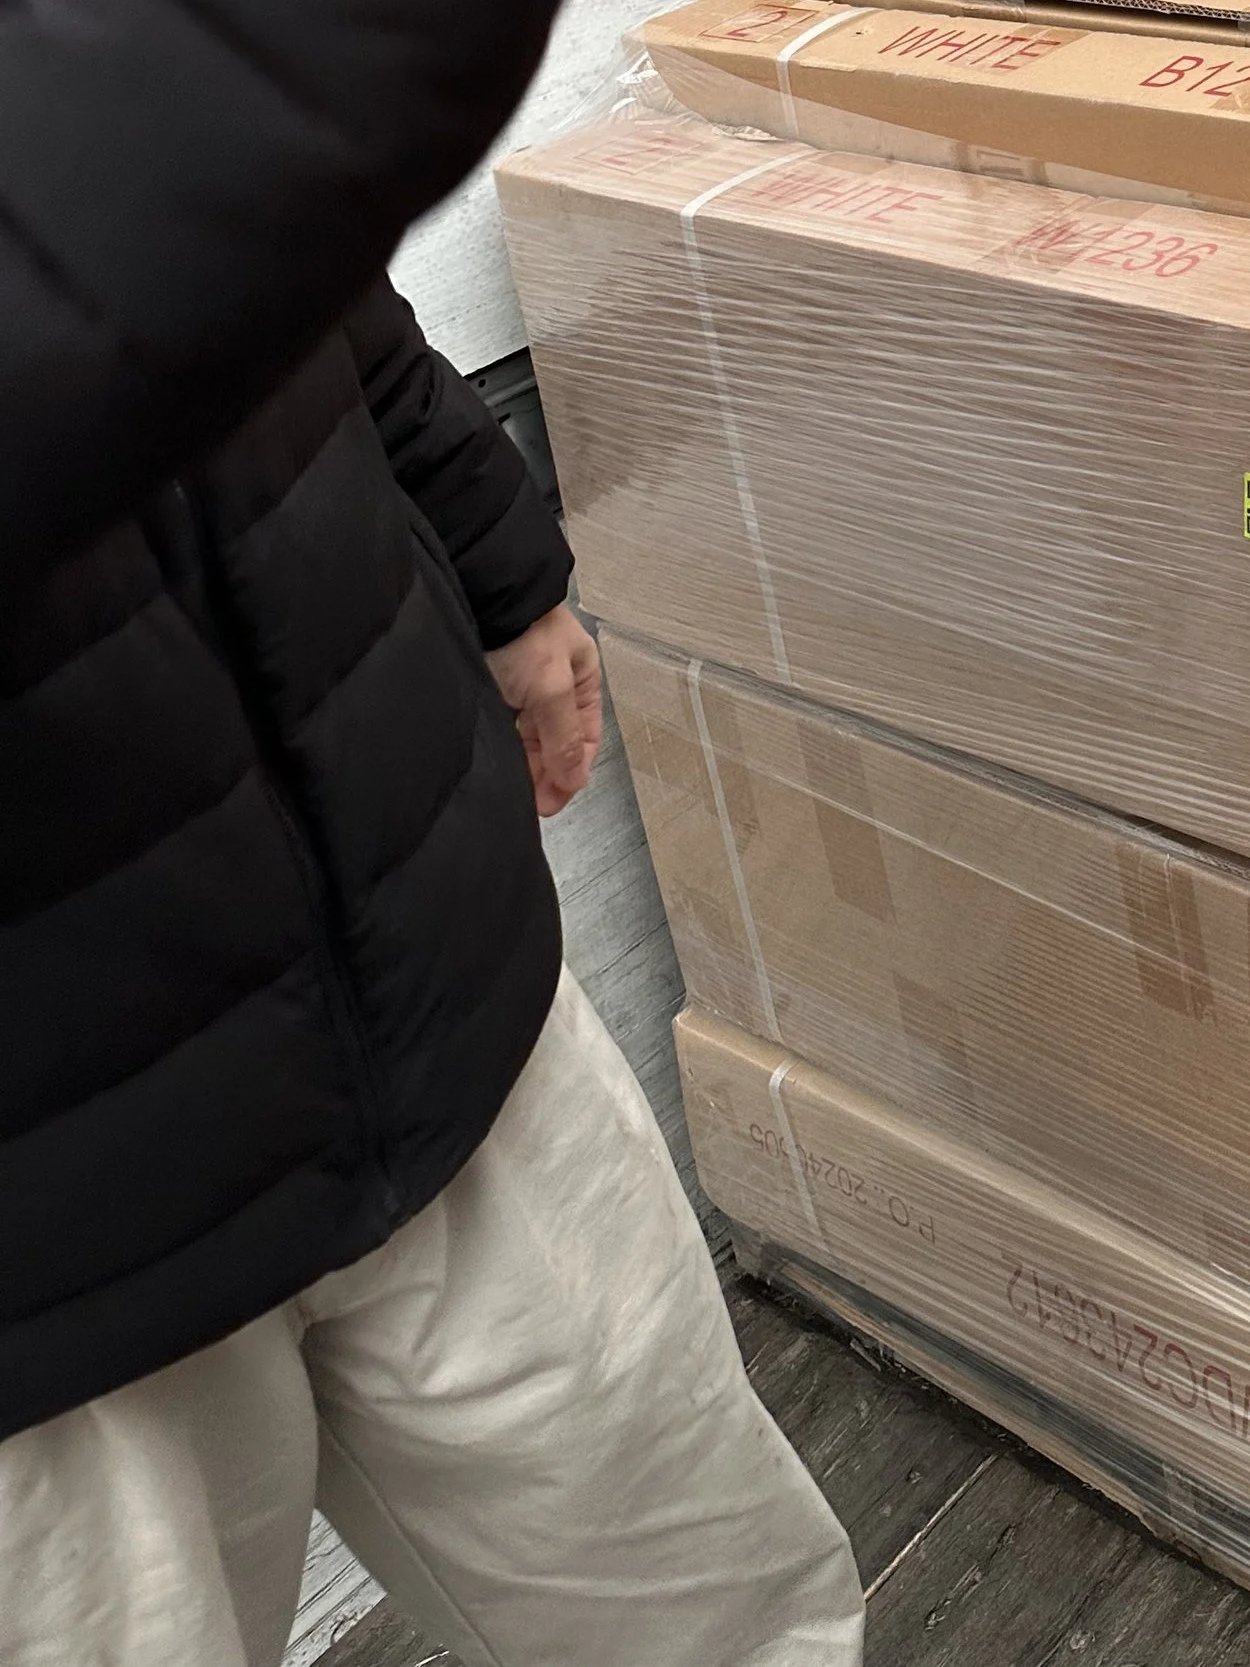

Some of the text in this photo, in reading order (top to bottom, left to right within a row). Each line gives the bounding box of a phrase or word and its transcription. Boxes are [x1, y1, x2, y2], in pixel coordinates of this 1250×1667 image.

[727, 7, 789, 40] 2
[878, 25, 1062, 70] WHITE
[751, 172, 1219, 278] WHITE W1236
